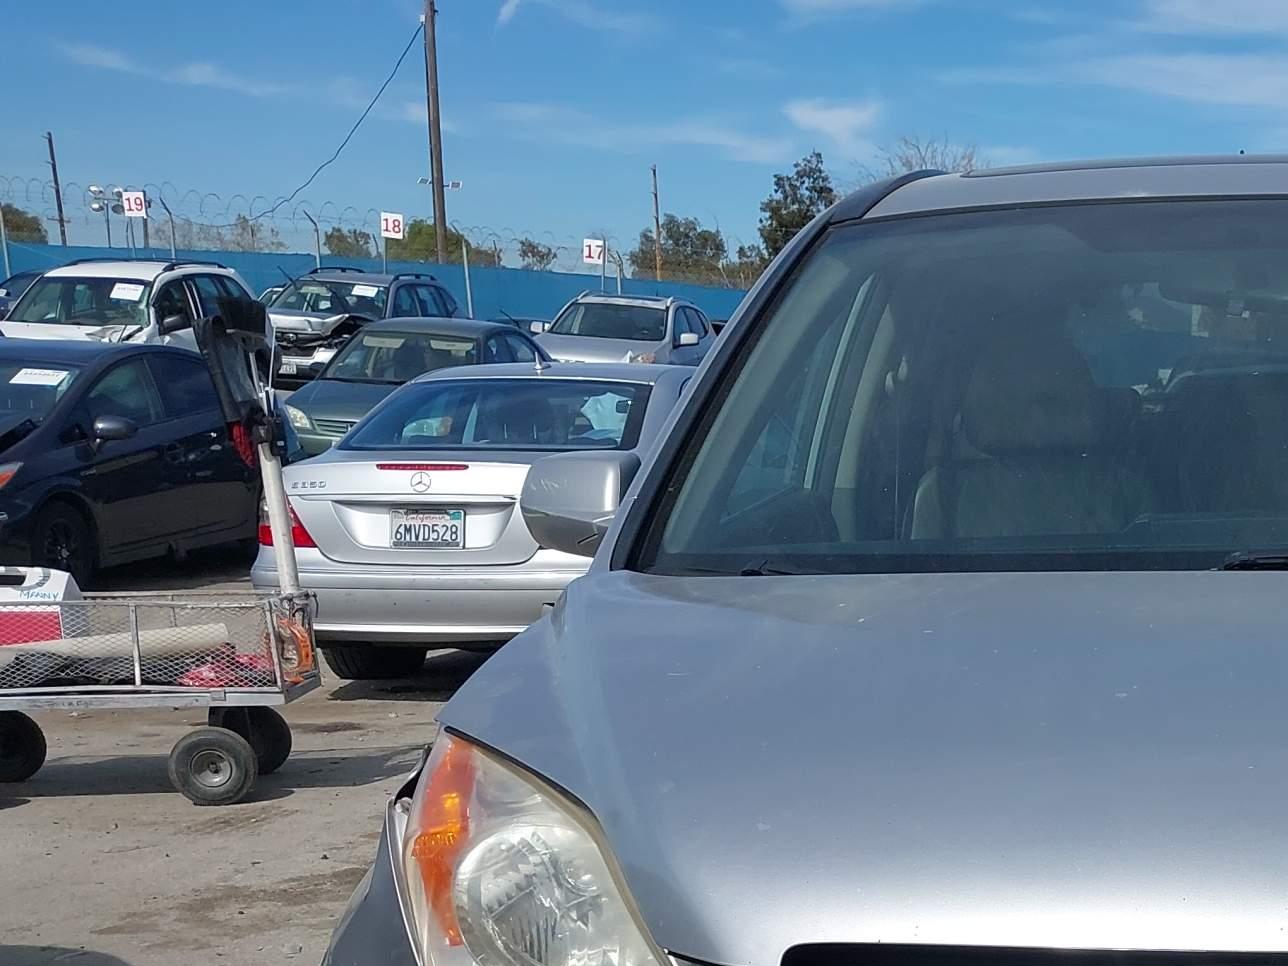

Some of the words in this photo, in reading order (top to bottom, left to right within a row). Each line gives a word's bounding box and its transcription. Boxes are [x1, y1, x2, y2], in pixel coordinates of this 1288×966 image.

[125, 197, 144, 212] 19
[383, 218, 401, 234] 18
[585, 244, 603, 260] 17
[394, 523, 459, 541] 6MVD528
